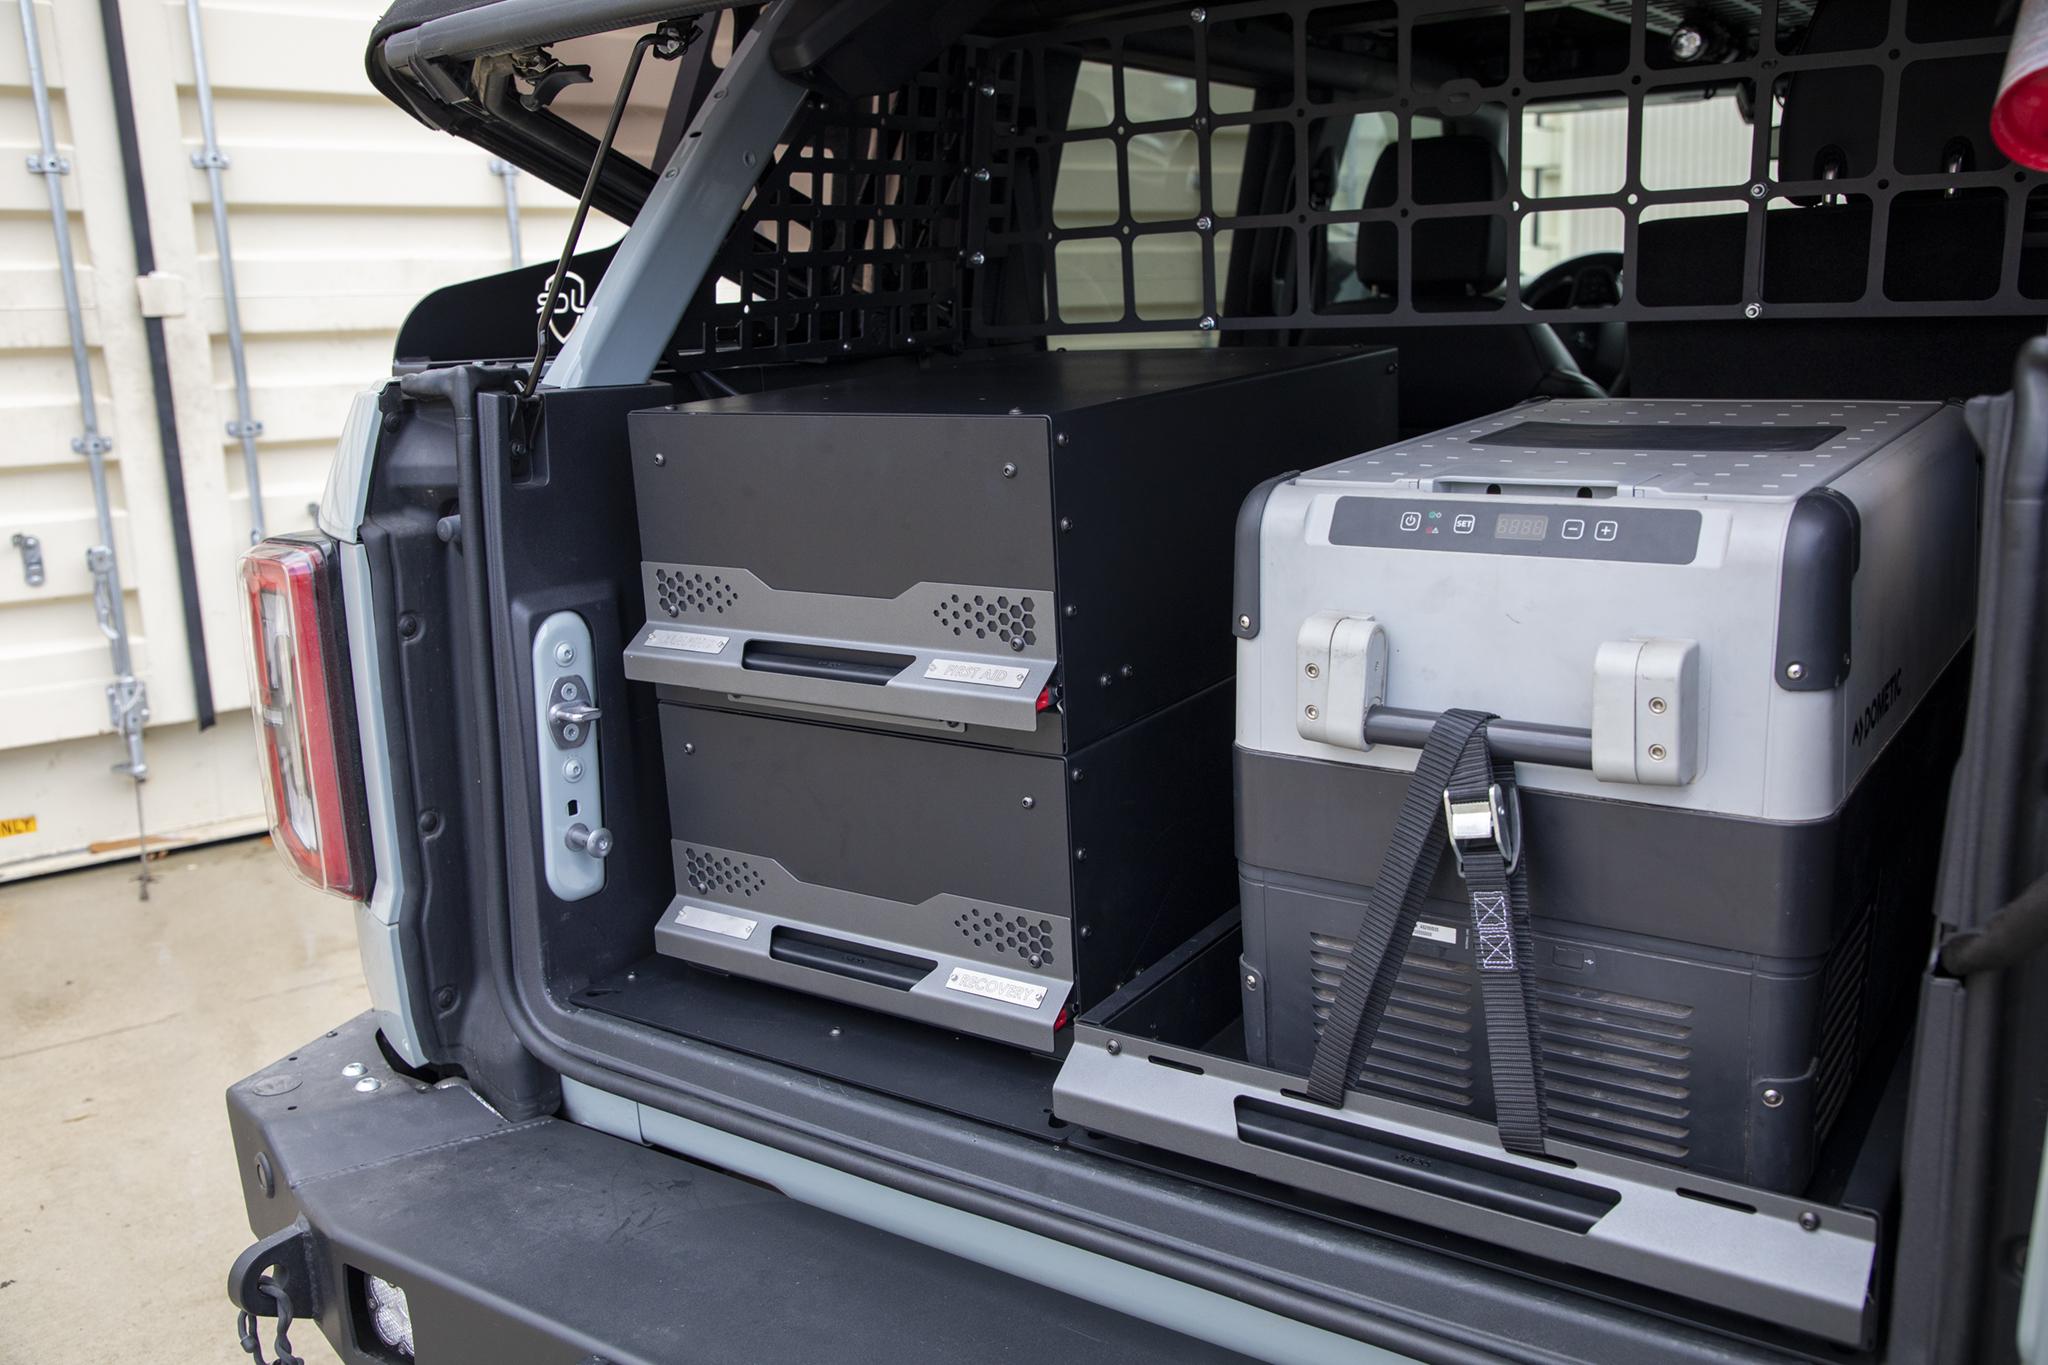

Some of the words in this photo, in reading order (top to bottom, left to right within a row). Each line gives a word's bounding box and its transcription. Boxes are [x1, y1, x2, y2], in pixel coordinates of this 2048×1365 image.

[1456, 519, 1473, 528] SET
[943, 663, 981, 680] FIRST
[979, 668, 1008, 682] AID
[1863, 666, 1902, 740] DOMETIC
[958, 972, 1036, 1001] RECOVERY
